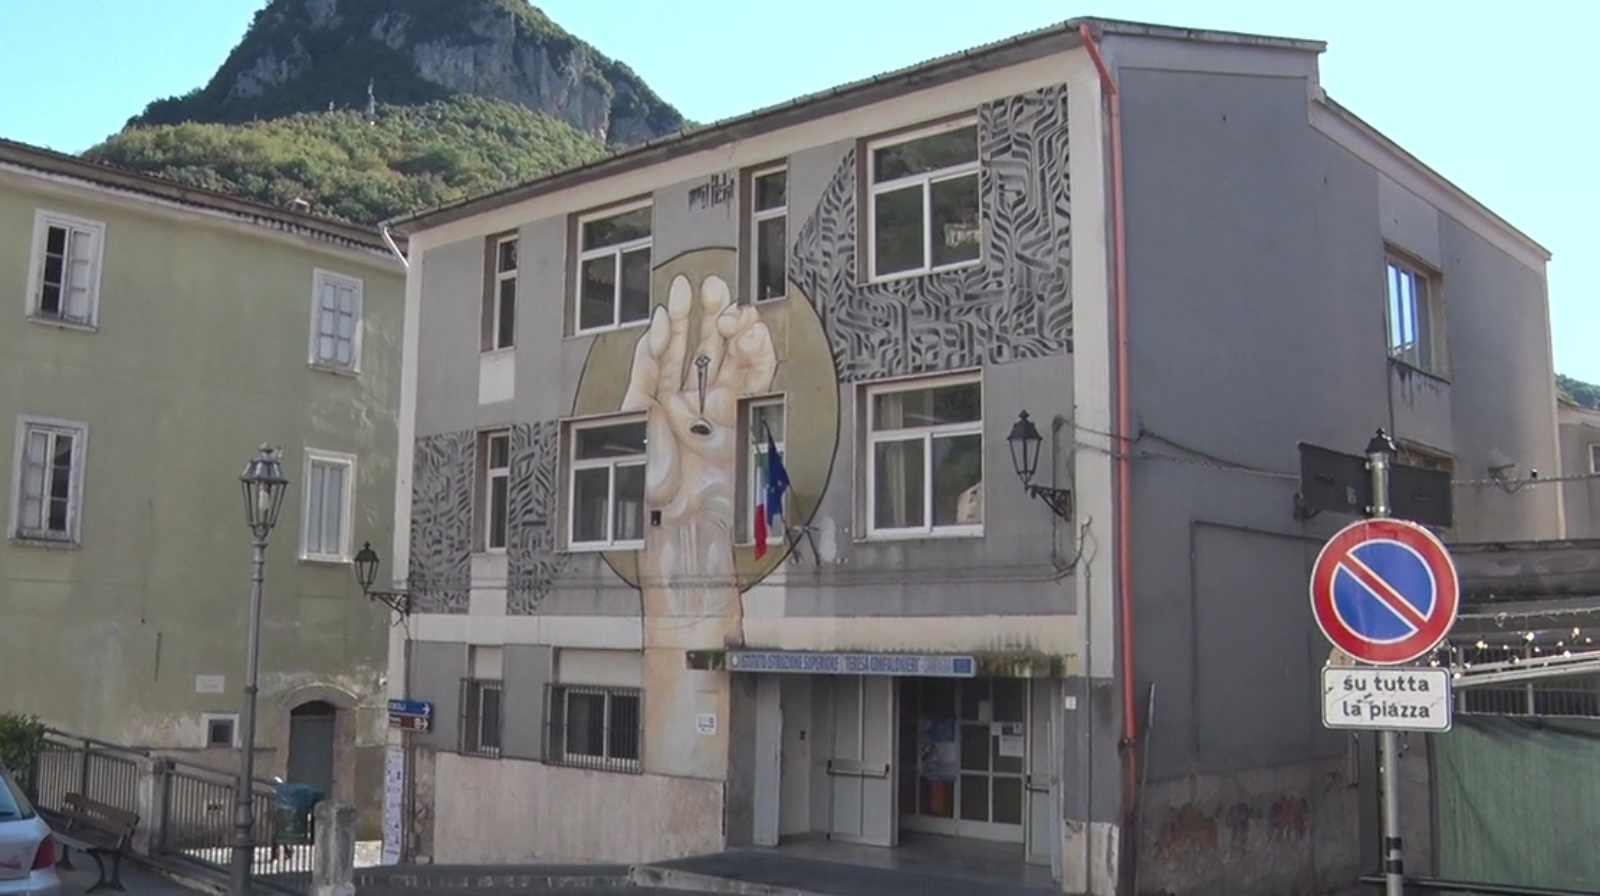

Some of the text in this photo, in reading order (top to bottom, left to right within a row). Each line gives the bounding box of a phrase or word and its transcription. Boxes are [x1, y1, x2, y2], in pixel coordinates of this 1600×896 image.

[1343, 676, 1429, 692] su tutta
[1343, 701, 1430, 720] la piazza
